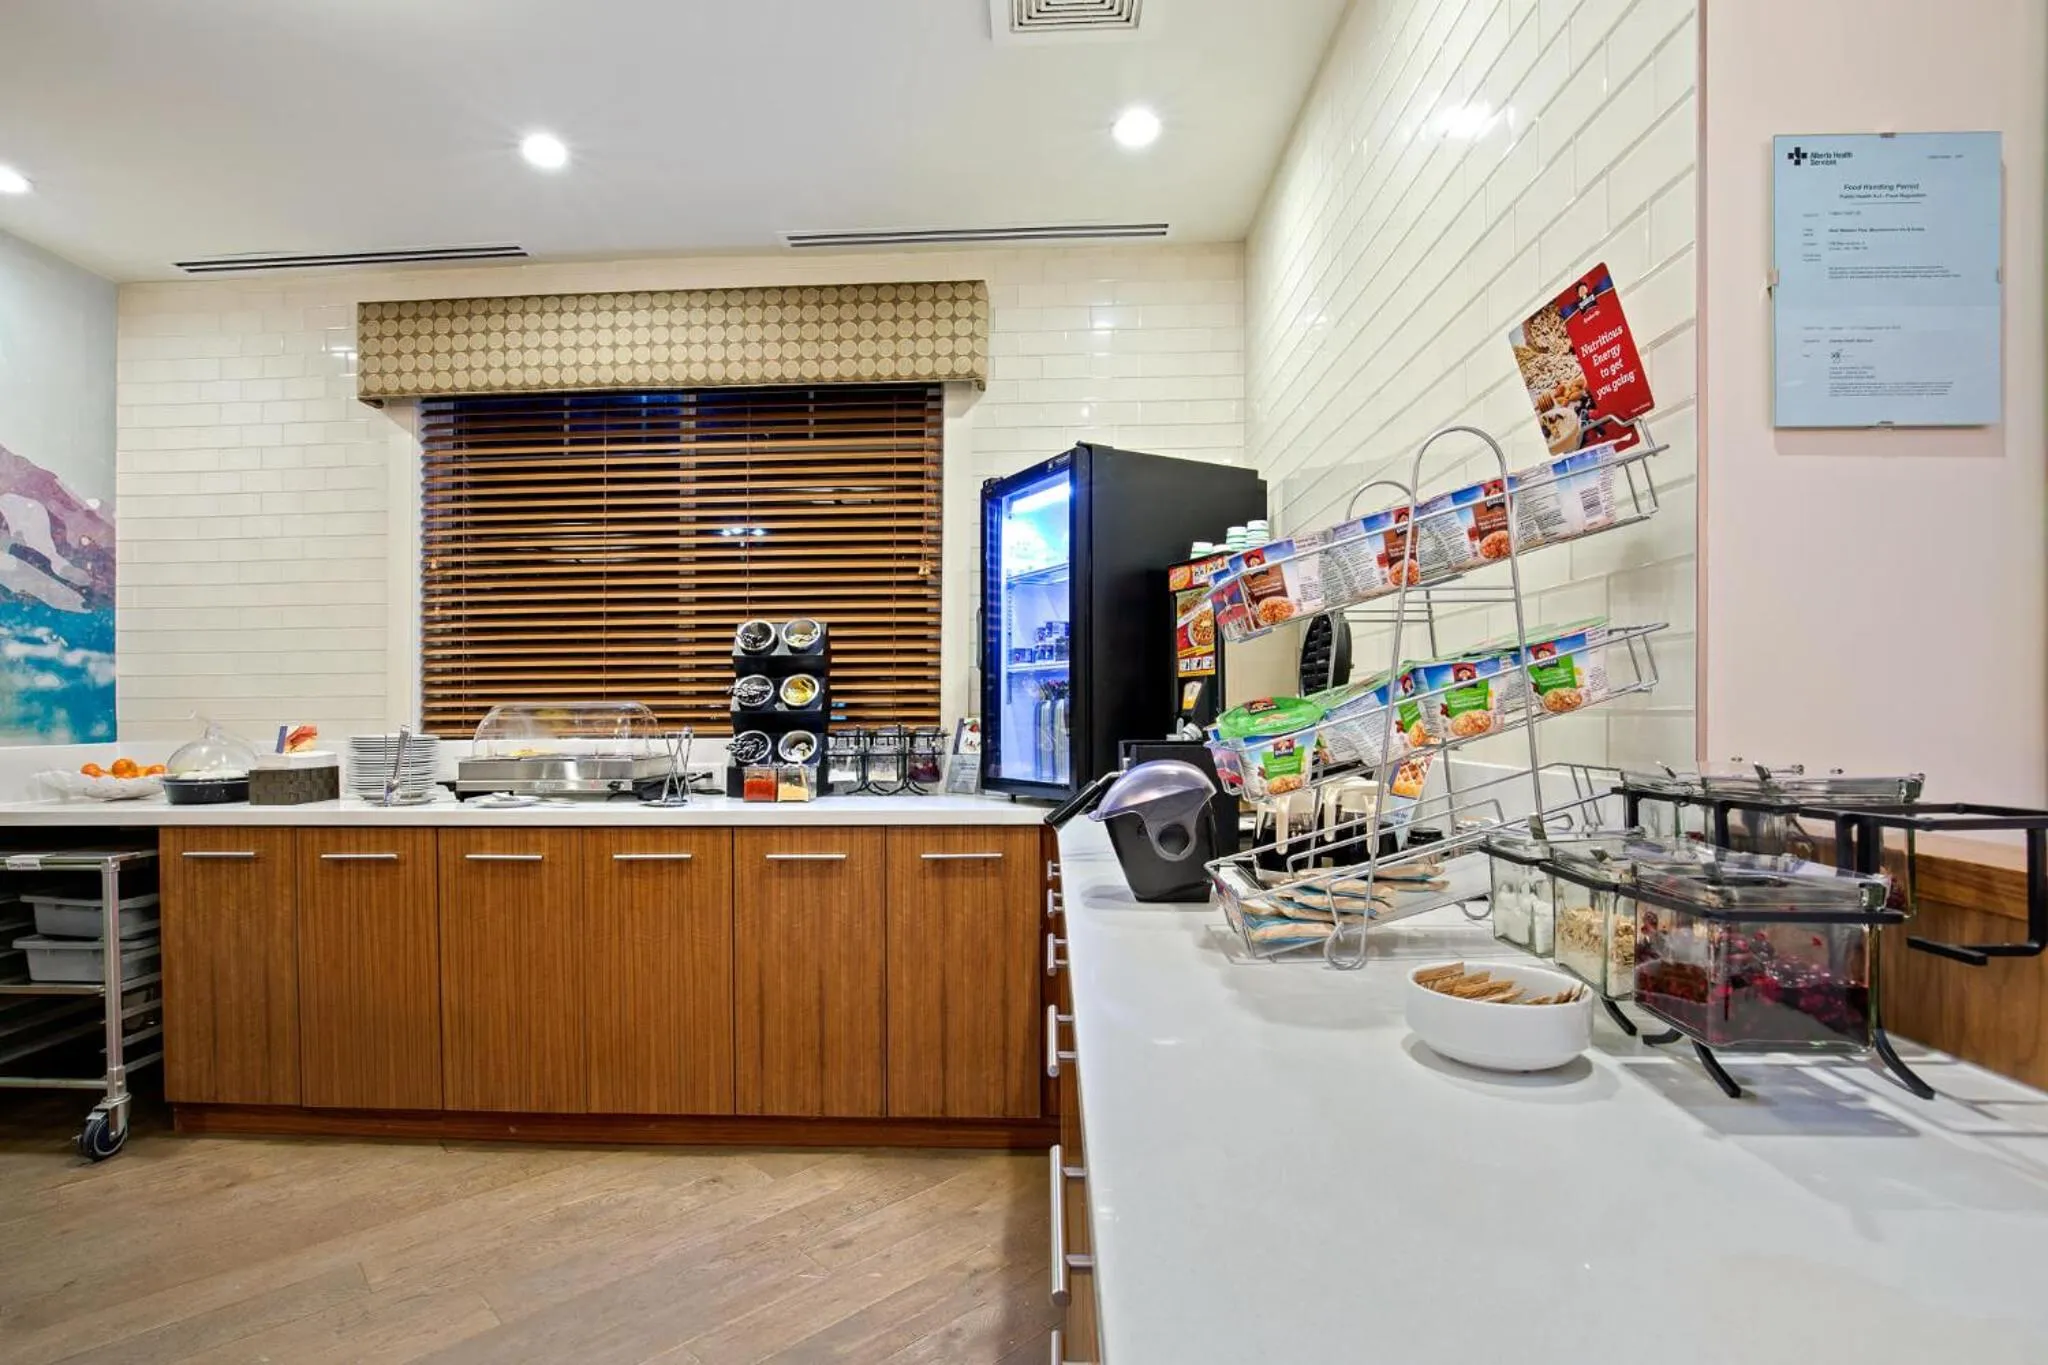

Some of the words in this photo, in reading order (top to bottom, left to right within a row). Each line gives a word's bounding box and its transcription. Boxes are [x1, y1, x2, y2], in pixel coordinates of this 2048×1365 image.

[1810, 151, 1832, 159] Alberta
[1833, 151, 1853, 159] Health
[1580, 325, 1623, 357] Nutritious
[1592, 344, 1621, 367] Energy
[1600, 367, 1609, 379] to
[1610, 358, 1624, 375] get
[1596, 384, 1612, 401] you
[1612, 371, 1635, 392] going
